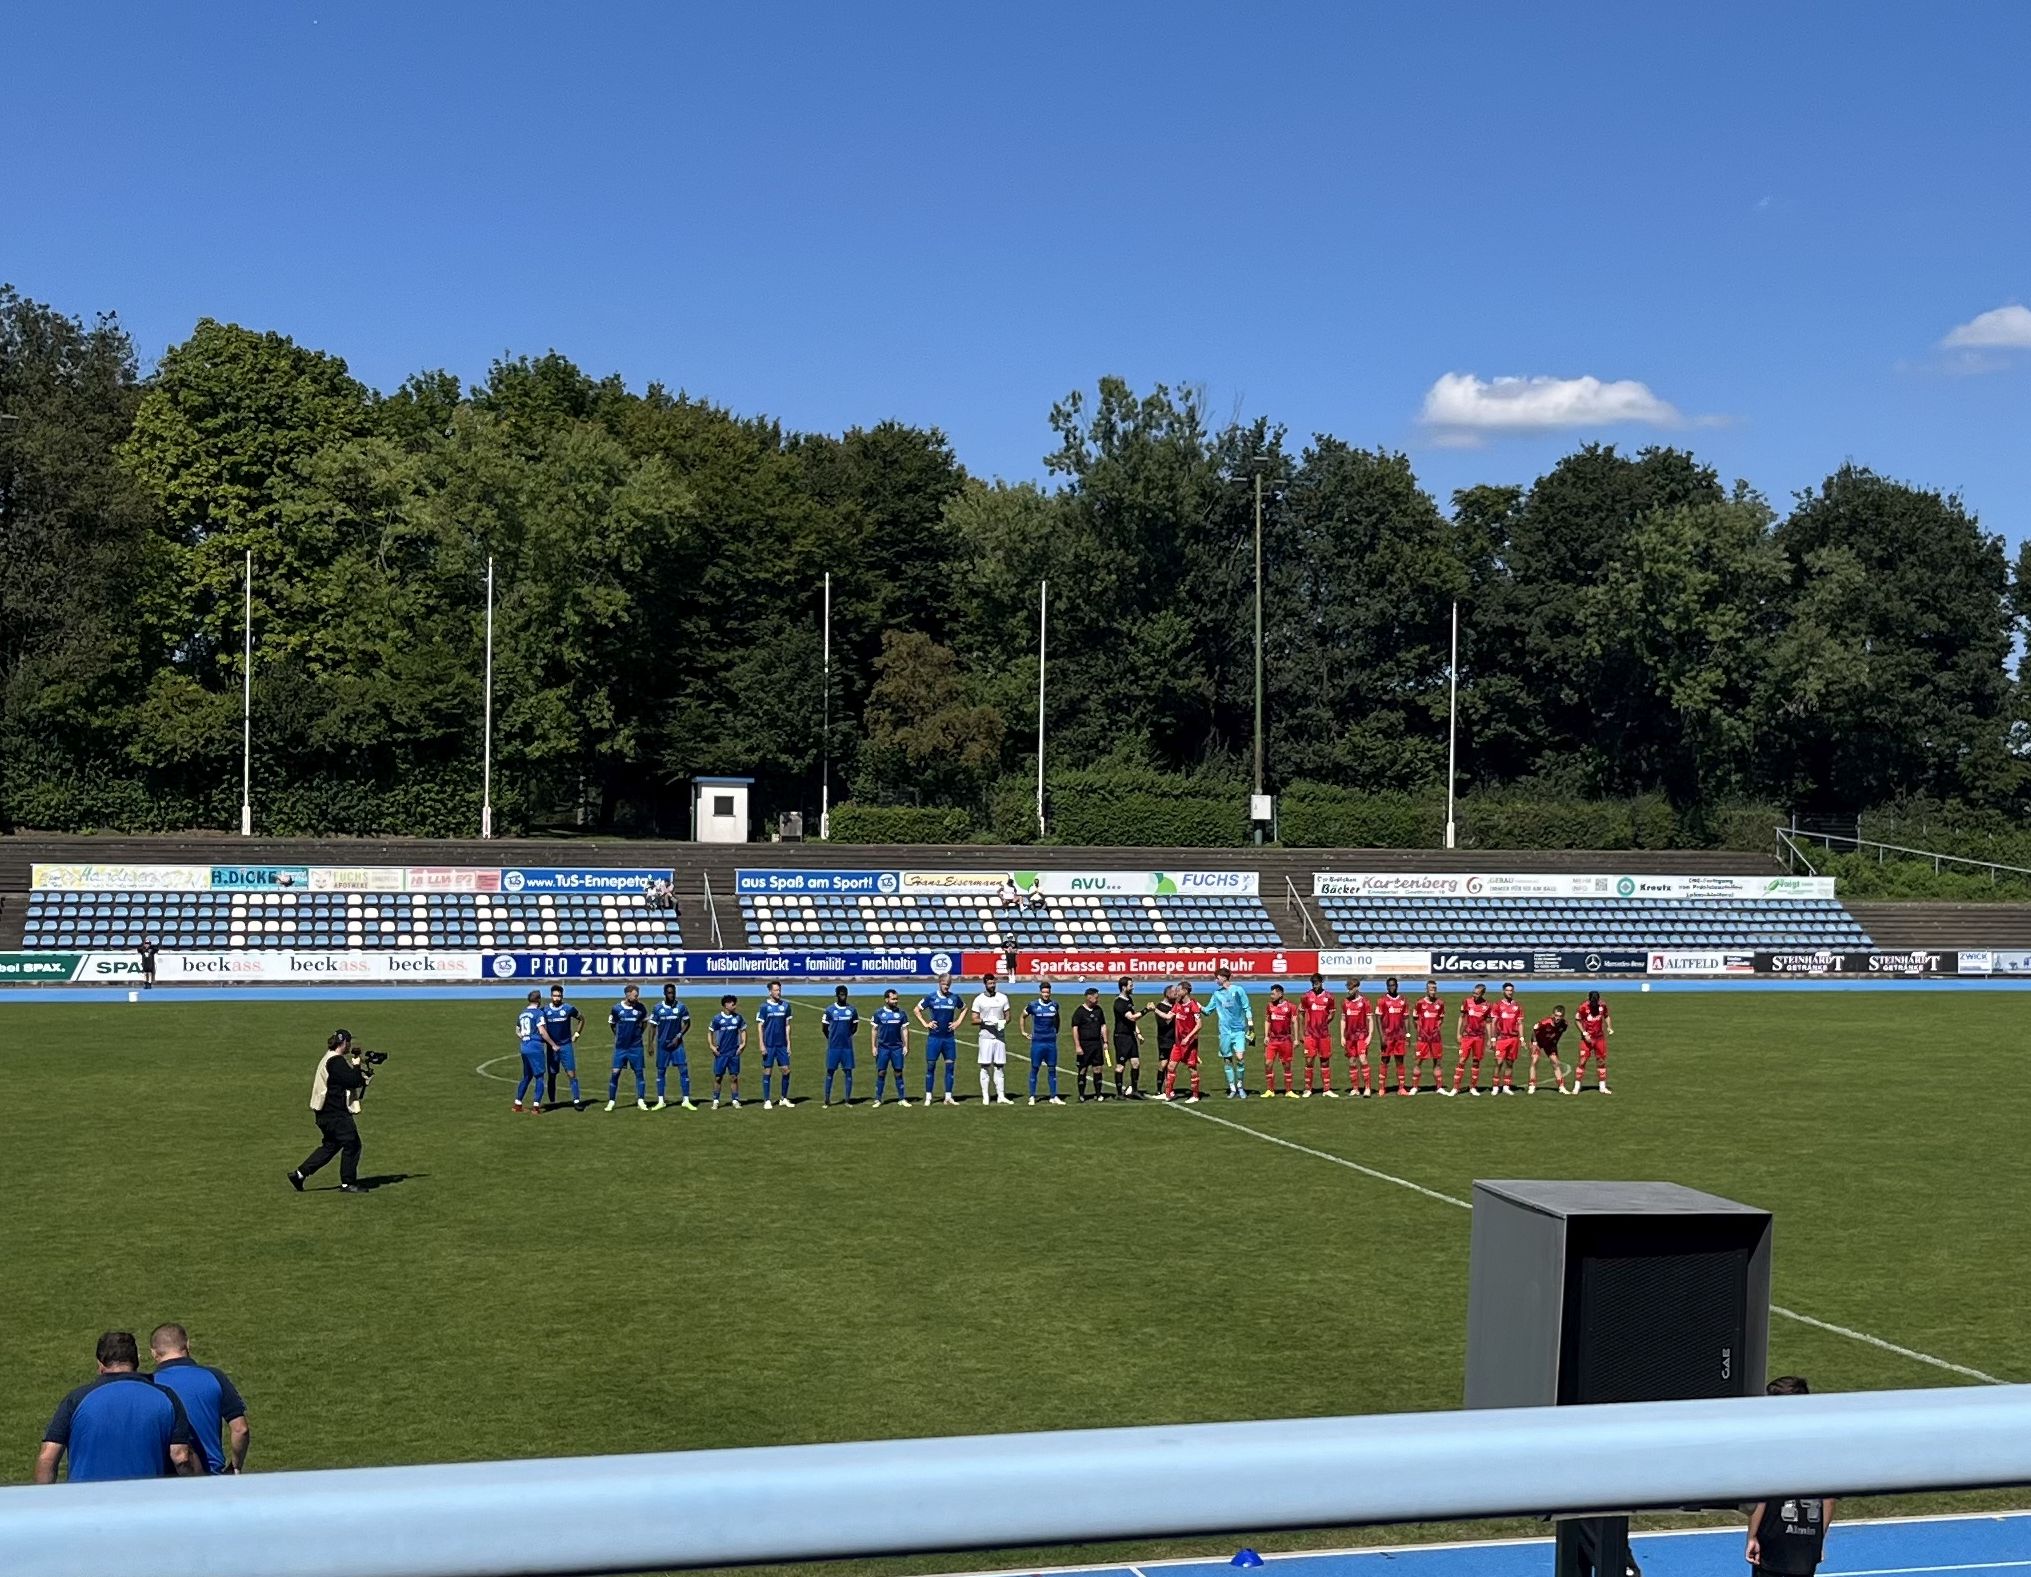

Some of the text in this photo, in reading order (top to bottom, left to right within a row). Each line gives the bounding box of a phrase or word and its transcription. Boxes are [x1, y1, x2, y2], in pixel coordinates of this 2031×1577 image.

[334, 871, 369, 882] FUCHS
[741, 875, 873, 891] aus Spaß am Sport!
[910, 876, 941, 887] Hans
[1182, 874, 1240, 887] FUCHS
[1321, 883, 1361, 895] Bäcker
[1362, 876, 1458, 893] Kartenberg
[23, 963, 66, 973] SPAX.
[96, 961, 145, 974] SPA
[530, 957, 688, 975] PRO ZUKUNFT
[706, 956, 917, 973] fußballverrückt familiär nachhaltig
[1030, 957, 1256, 975] Sparkasse an Ennepe und Ruhr
[1665, 958, 1719, 969] ALTFELD
[1772, 955, 1845, 971] STEINHARDT
[1868, 955, 1941, 971] STEINHARDT
